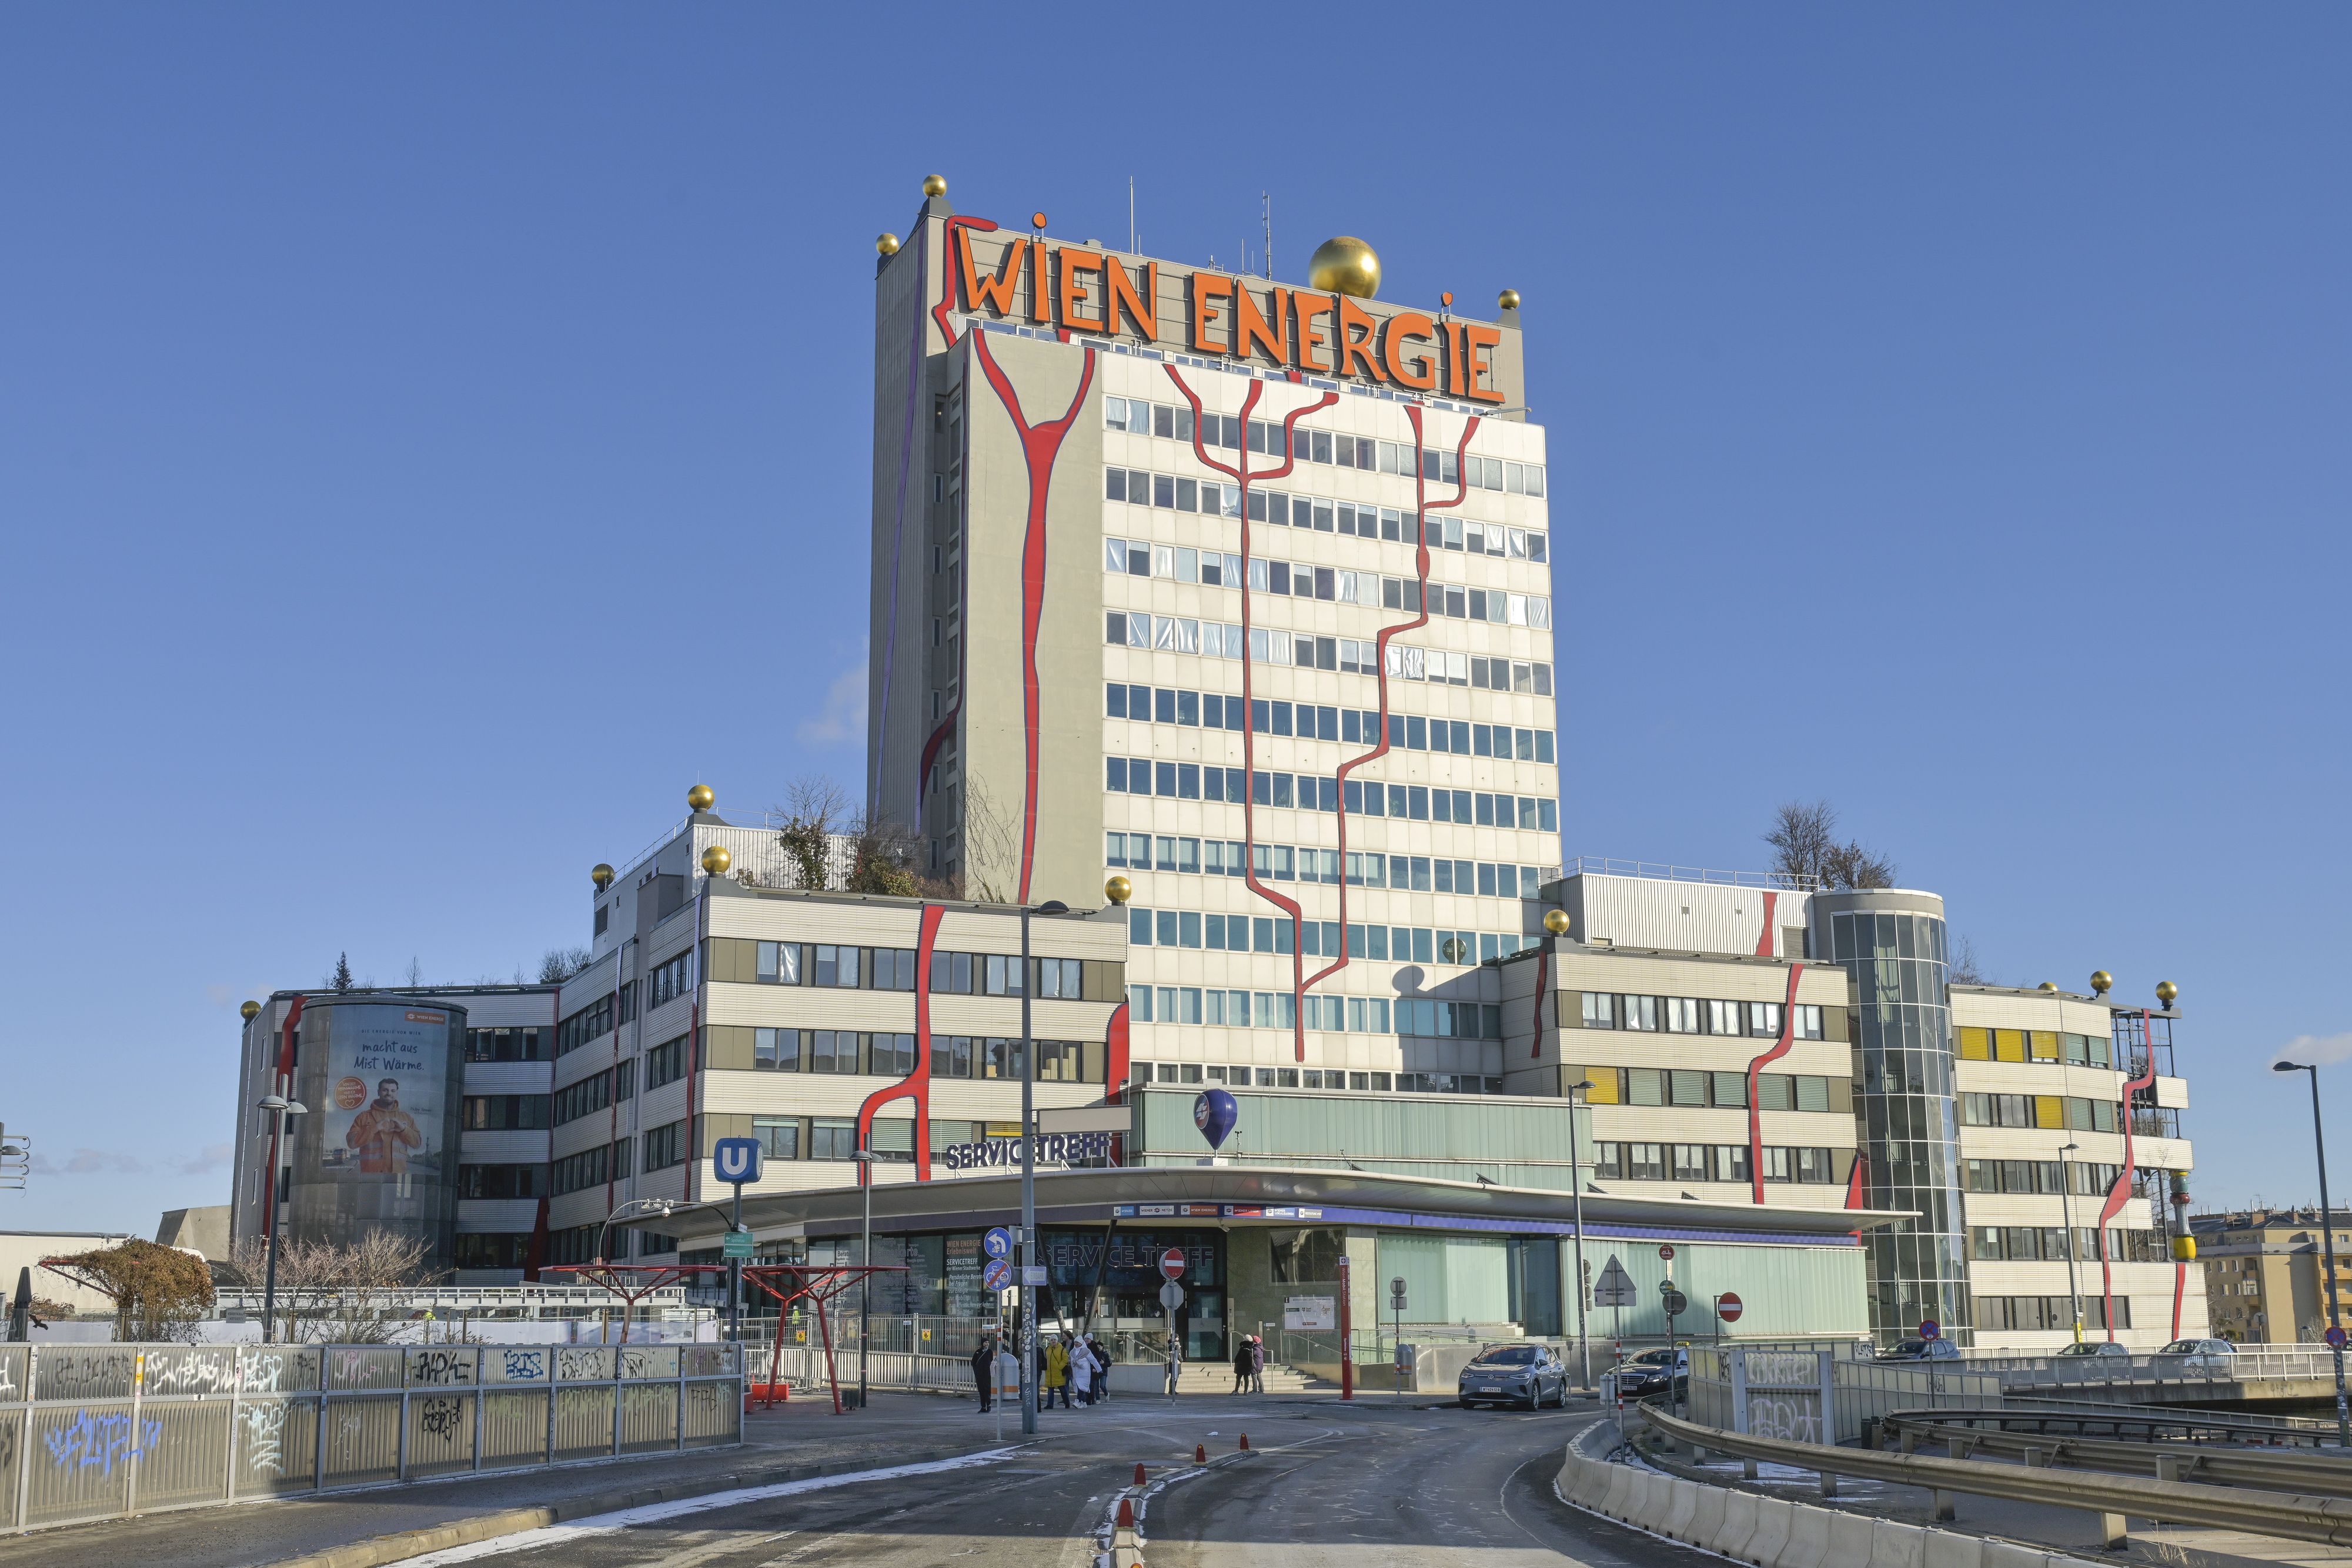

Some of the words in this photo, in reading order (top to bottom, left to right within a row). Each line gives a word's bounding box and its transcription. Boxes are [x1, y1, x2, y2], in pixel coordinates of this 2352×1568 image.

[957, 212, 1158, 342] WIEN
[1192, 272, 1505, 404] ENERGIE
[362, 1040, 398, 1052] macht
[400, 1045, 417, 1054] aus
[354, 1056, 379, 1069] Mist
[383, 1058, 425, 1071] Wärme.
[722, 1147, 748, 1175] U
[946, 1132, 1111, 1169] SERVICTREFF
[1030, 1271, 1044, 1280] EINBAHN
